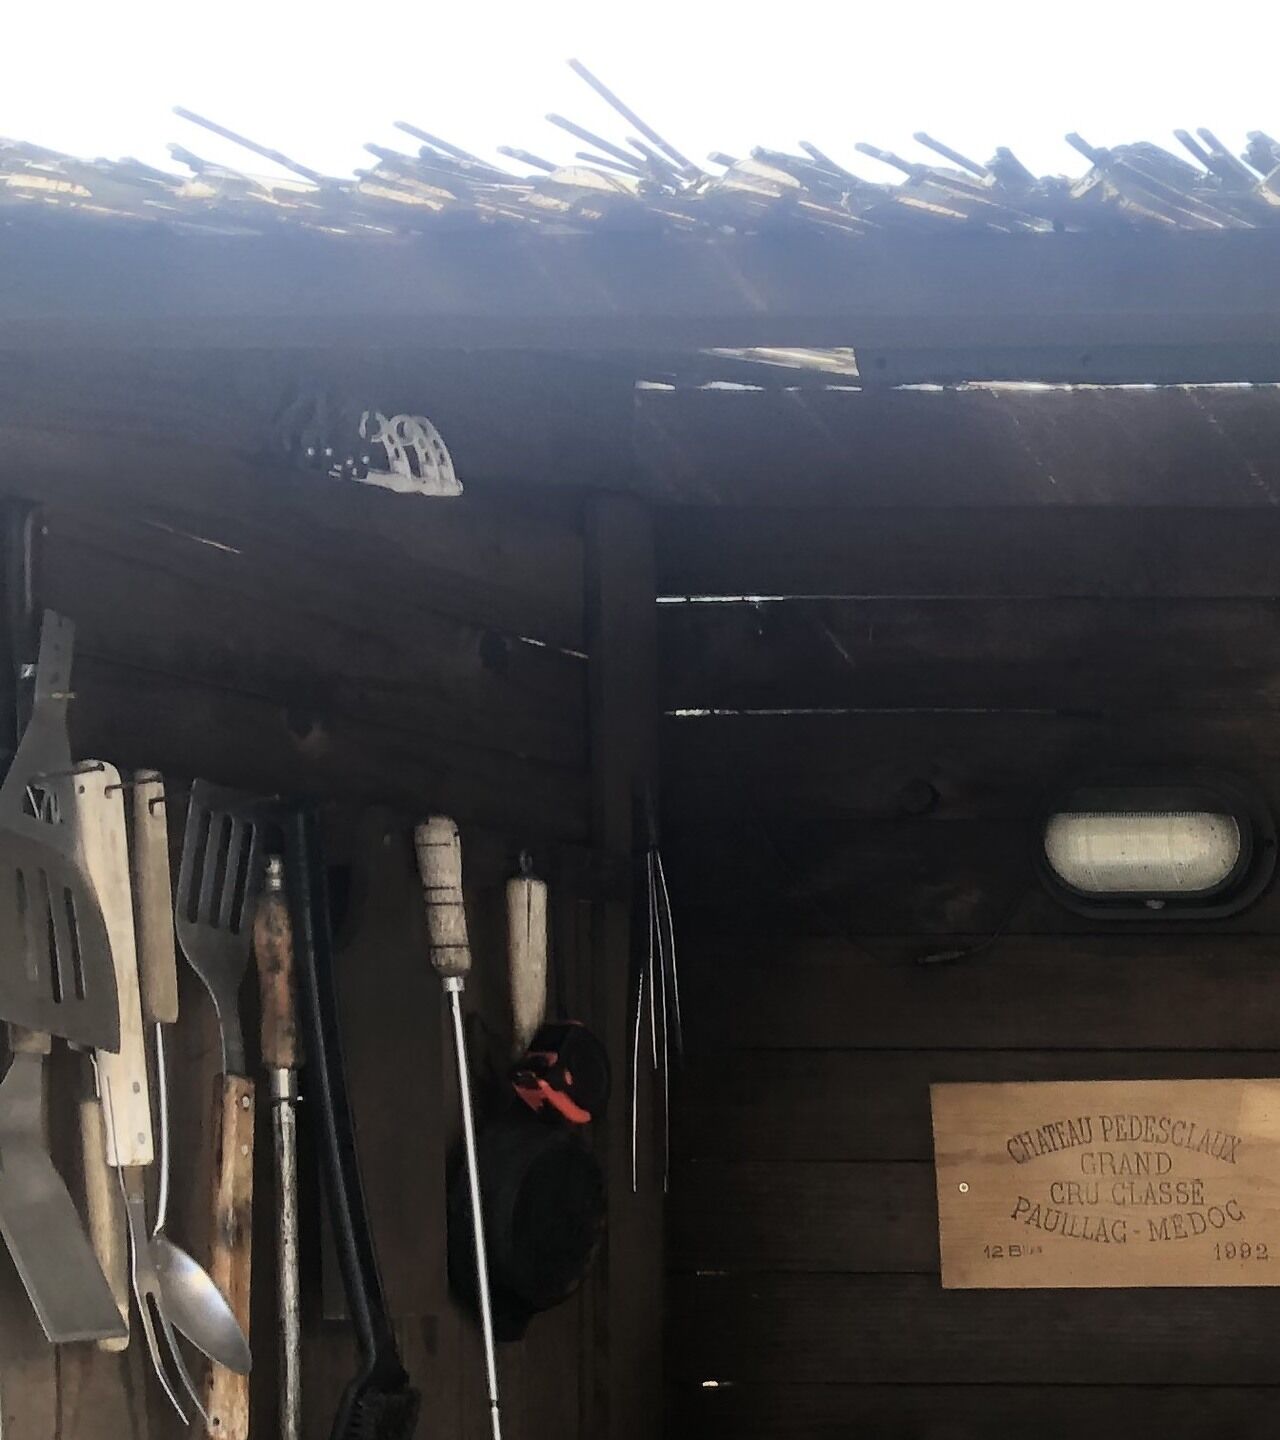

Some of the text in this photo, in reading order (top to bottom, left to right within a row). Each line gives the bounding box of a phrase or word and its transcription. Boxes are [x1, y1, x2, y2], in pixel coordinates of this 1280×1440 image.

[1080, 1151, 1172, 1176] GRAND
[1050, 1181, 1099, 1206] CRU
[1010, 1196, 1127, 1243] PAUILLAC
[984, 1245, 1004, 1259] 12
[1214, 1242, 1269, 1261] 1992
